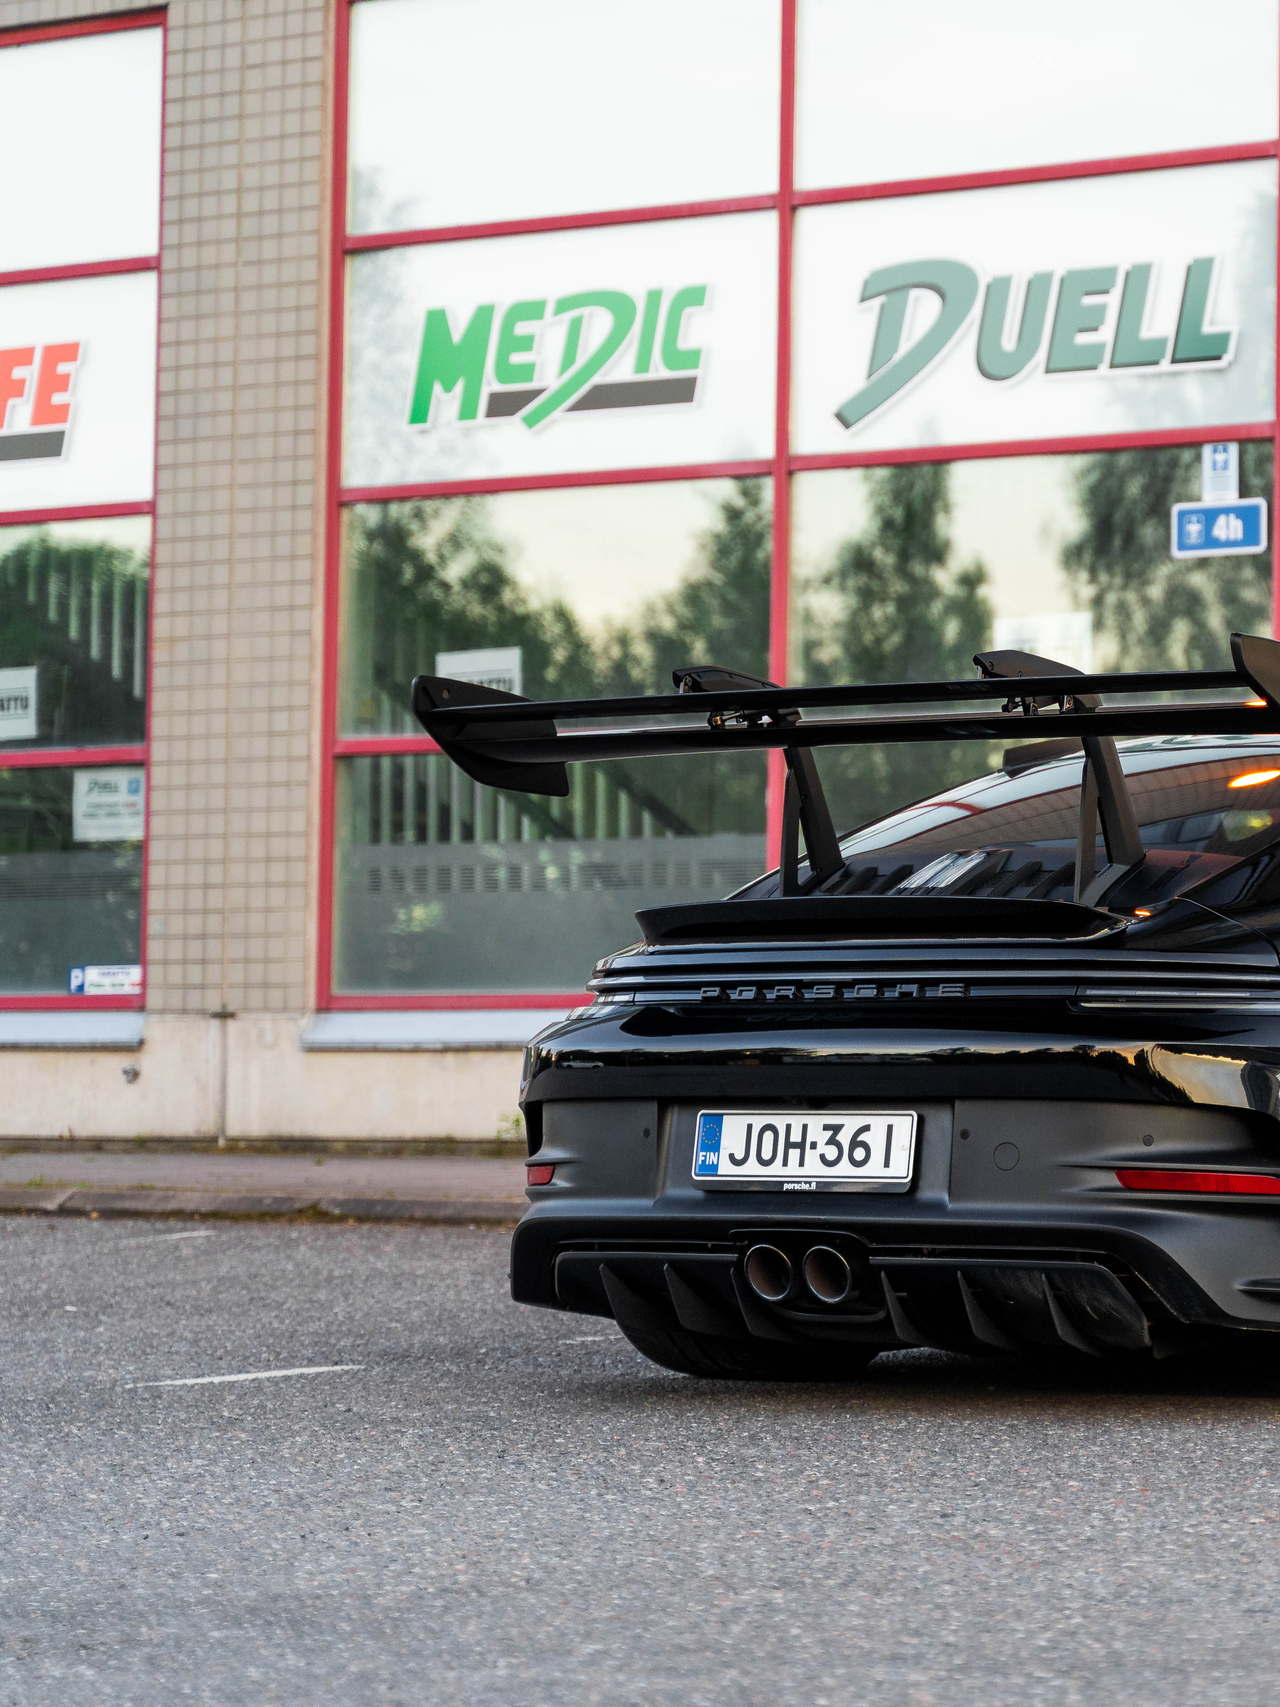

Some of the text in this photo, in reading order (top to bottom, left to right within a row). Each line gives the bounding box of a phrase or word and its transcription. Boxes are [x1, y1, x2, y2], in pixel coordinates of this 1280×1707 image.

[407, 285, 708, 429] MEDIC
[834, 258, 1232, 429] DUELL
[1211, 512, 1244, 542] 4h
[700, 983, 966, 1000] PORSCHE
[698, 1151, 719, 1166] FIN
[728, 1123, 894, 1169] JOH-361
[783, 1181, 817, 1191] porsche.fi
